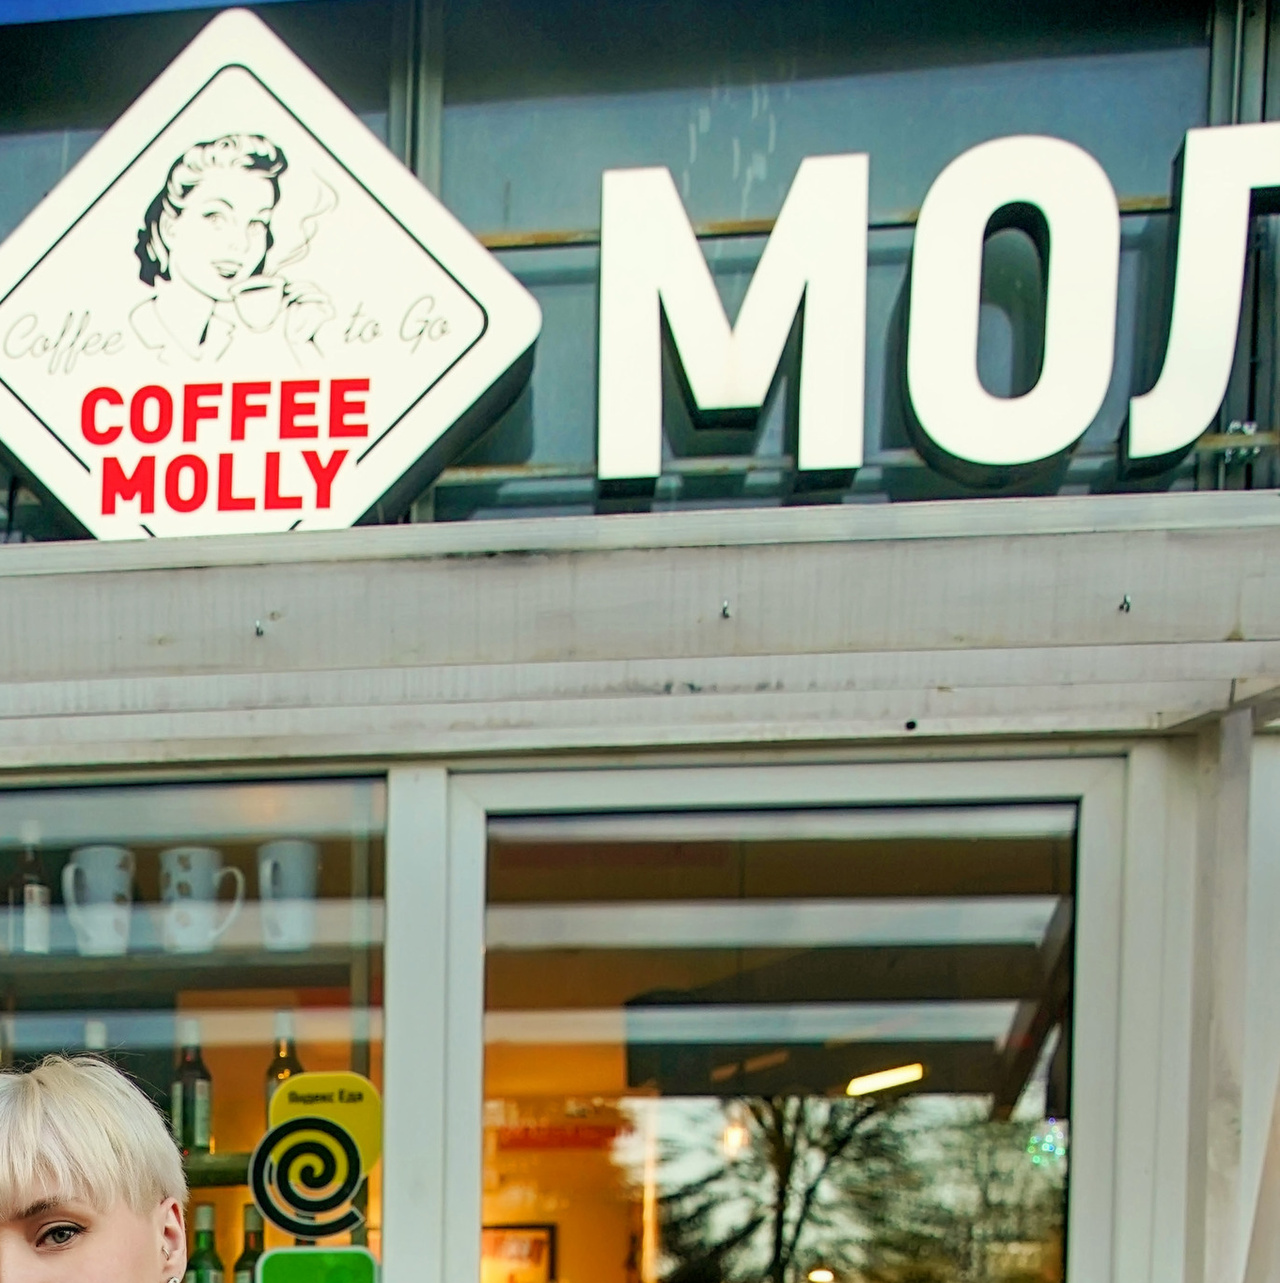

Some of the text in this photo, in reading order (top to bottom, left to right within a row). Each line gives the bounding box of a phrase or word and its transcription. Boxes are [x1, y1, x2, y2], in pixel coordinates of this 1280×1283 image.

[3, 295, 451, 375] Coffee to Go
[79, 377, 370, 445] COFFEE
[99, 449, 351, 517] MOLLY
